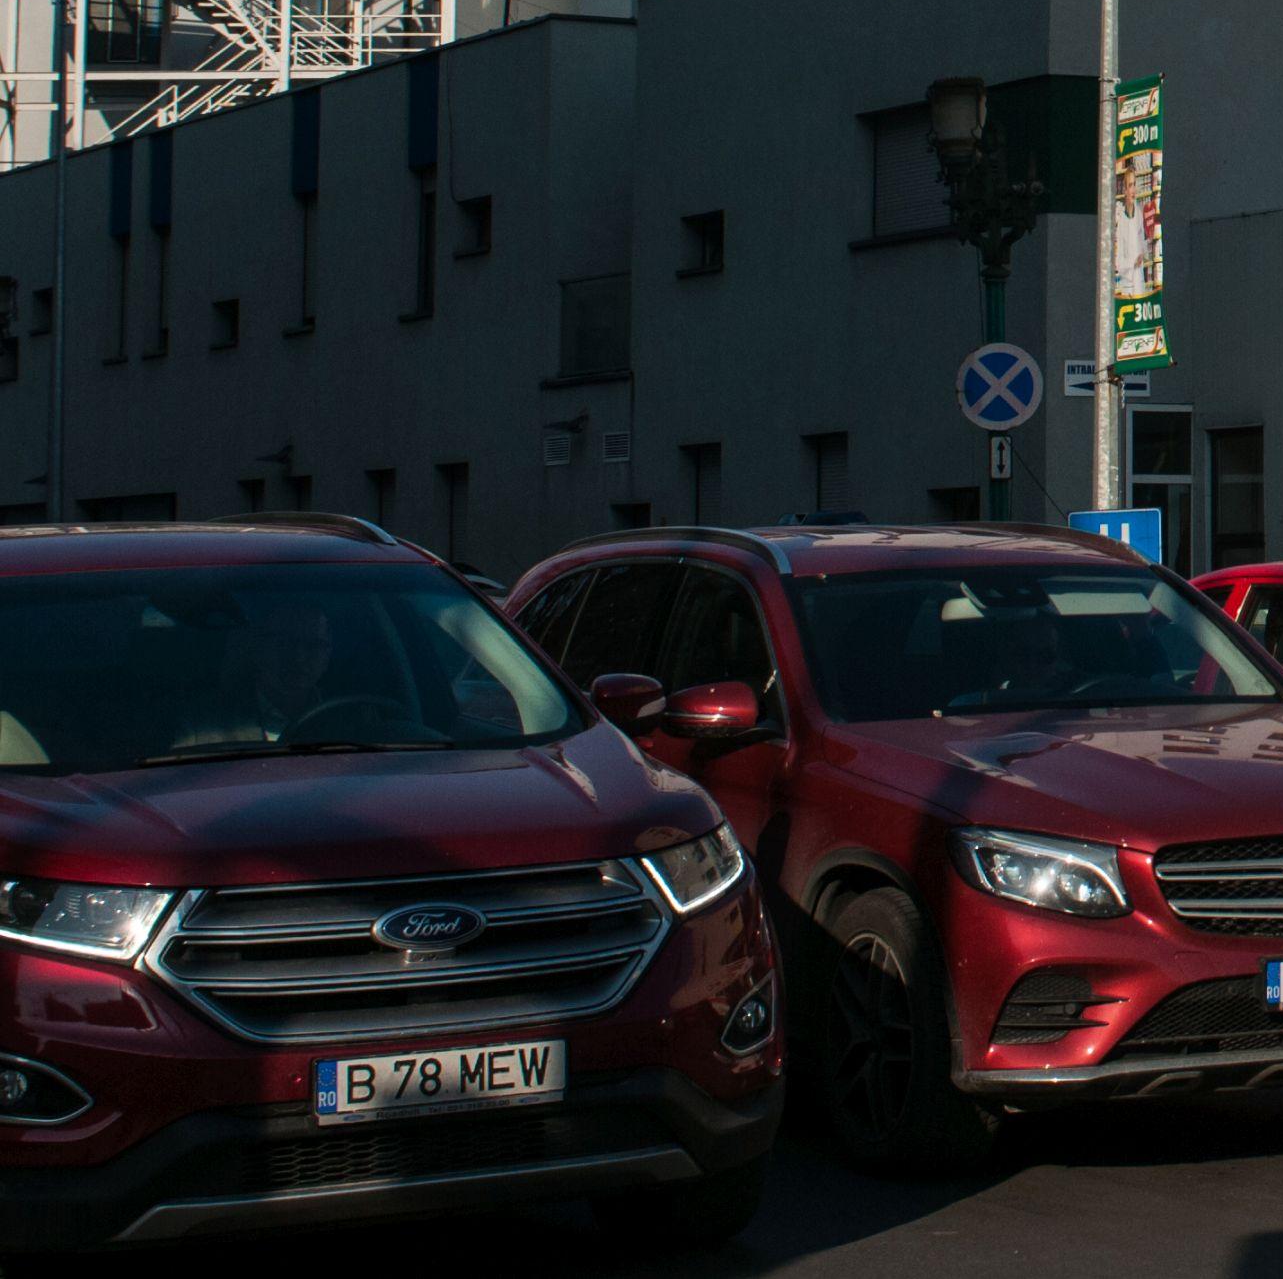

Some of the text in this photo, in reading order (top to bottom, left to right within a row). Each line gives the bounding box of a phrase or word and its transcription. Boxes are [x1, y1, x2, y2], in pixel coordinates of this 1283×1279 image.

[1133, 124, 1148, 145] 300
[1135, 302, 1152, 322] 300
[402, 912, 462, 937] Ford
[1267, 986, 1280, 1000] RO
[318, 1045, 550, 1108] RO B 78 MEW
